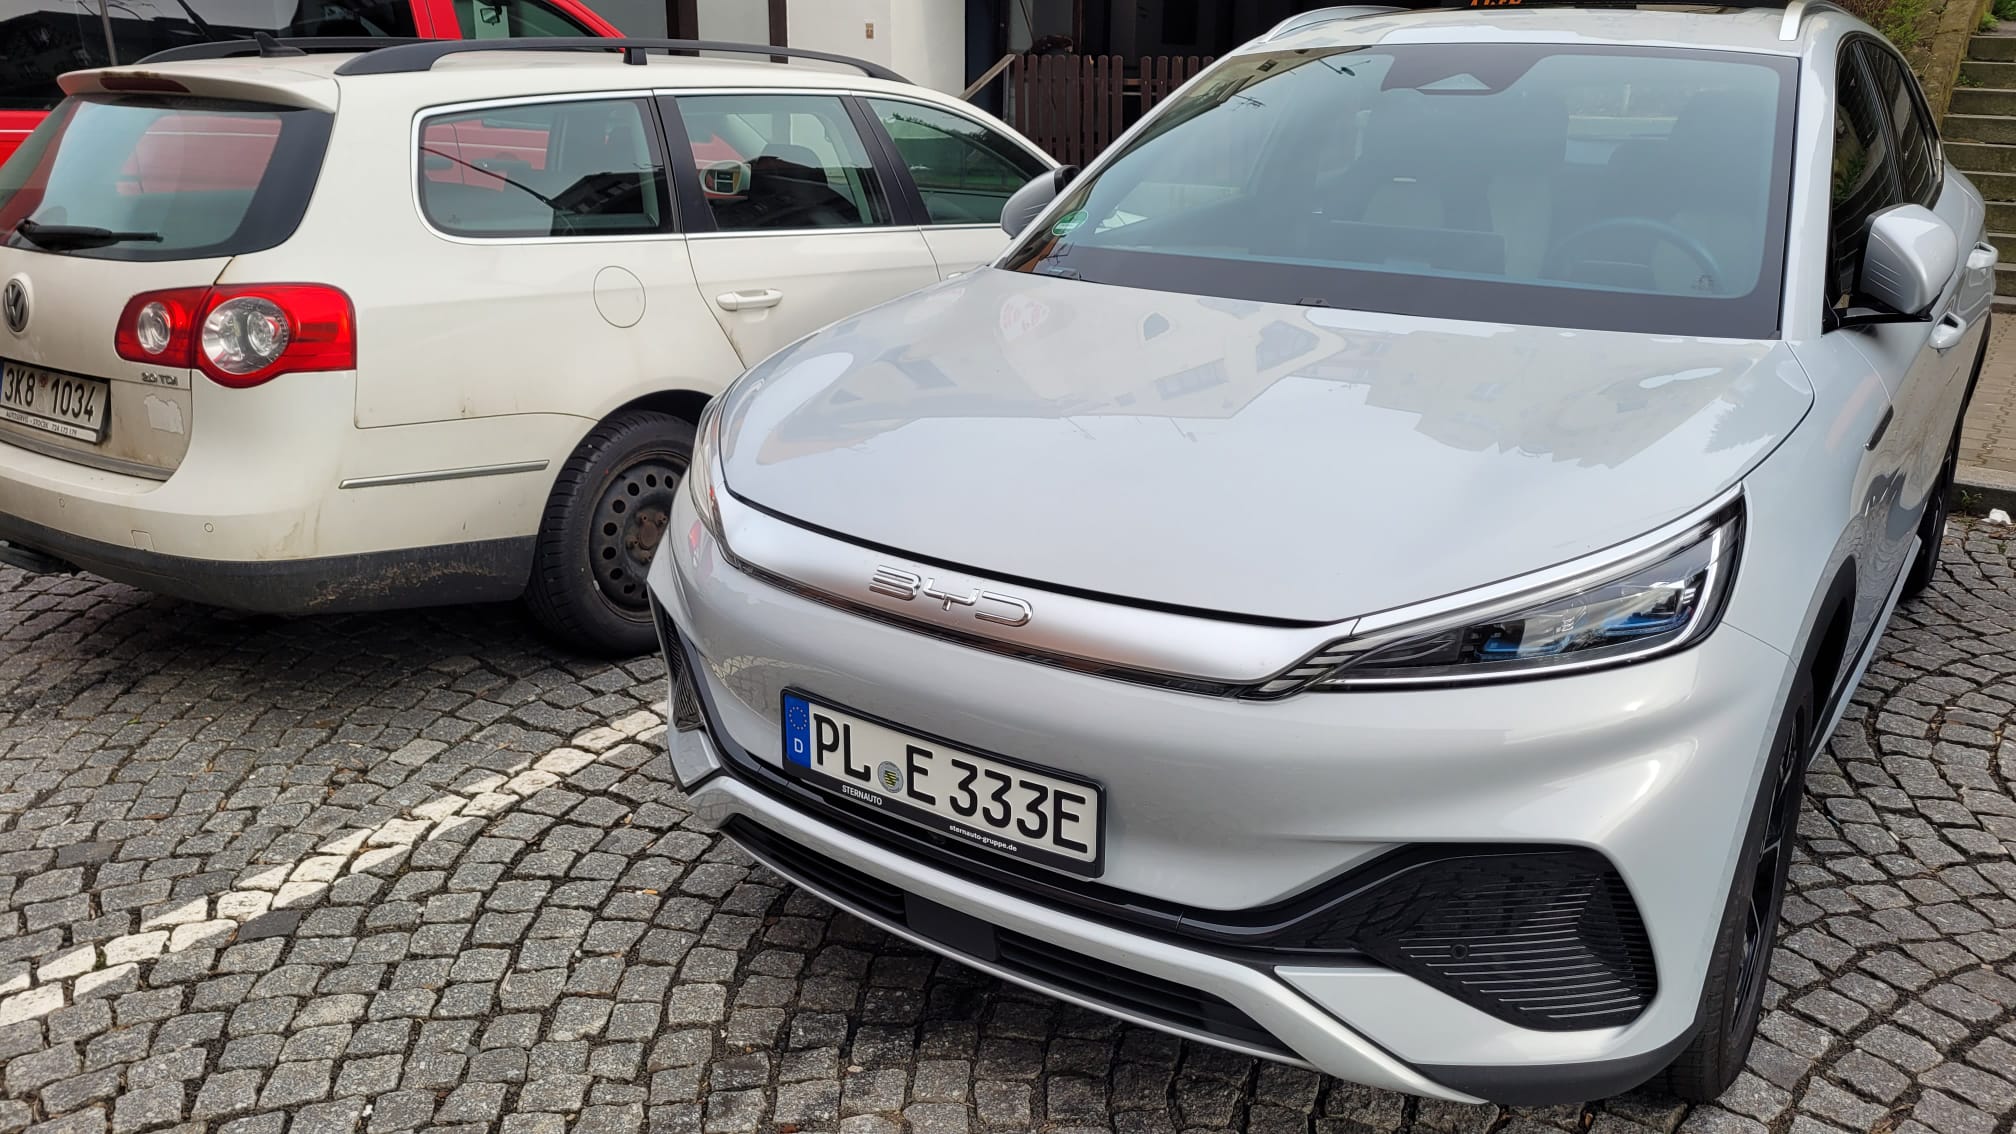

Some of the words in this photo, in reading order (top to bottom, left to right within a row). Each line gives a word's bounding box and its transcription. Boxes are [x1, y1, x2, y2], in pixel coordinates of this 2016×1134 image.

[158, 374, 179, 386] TDI
[5, 367, 36, 407] 3K8
[51, 377, 96, 423] 1034
[869, 564, 1033, 627] BYD
[793, 737, 804, 754] D
[813, 712, 872, 783] PL
[906, 743, 937, 806] E
[950, 757, 1089, 854] 333E
[841, 784, 883, 806] STERNAUTO
[949, 825, 1018, 852] sternauto-gruppe.de
